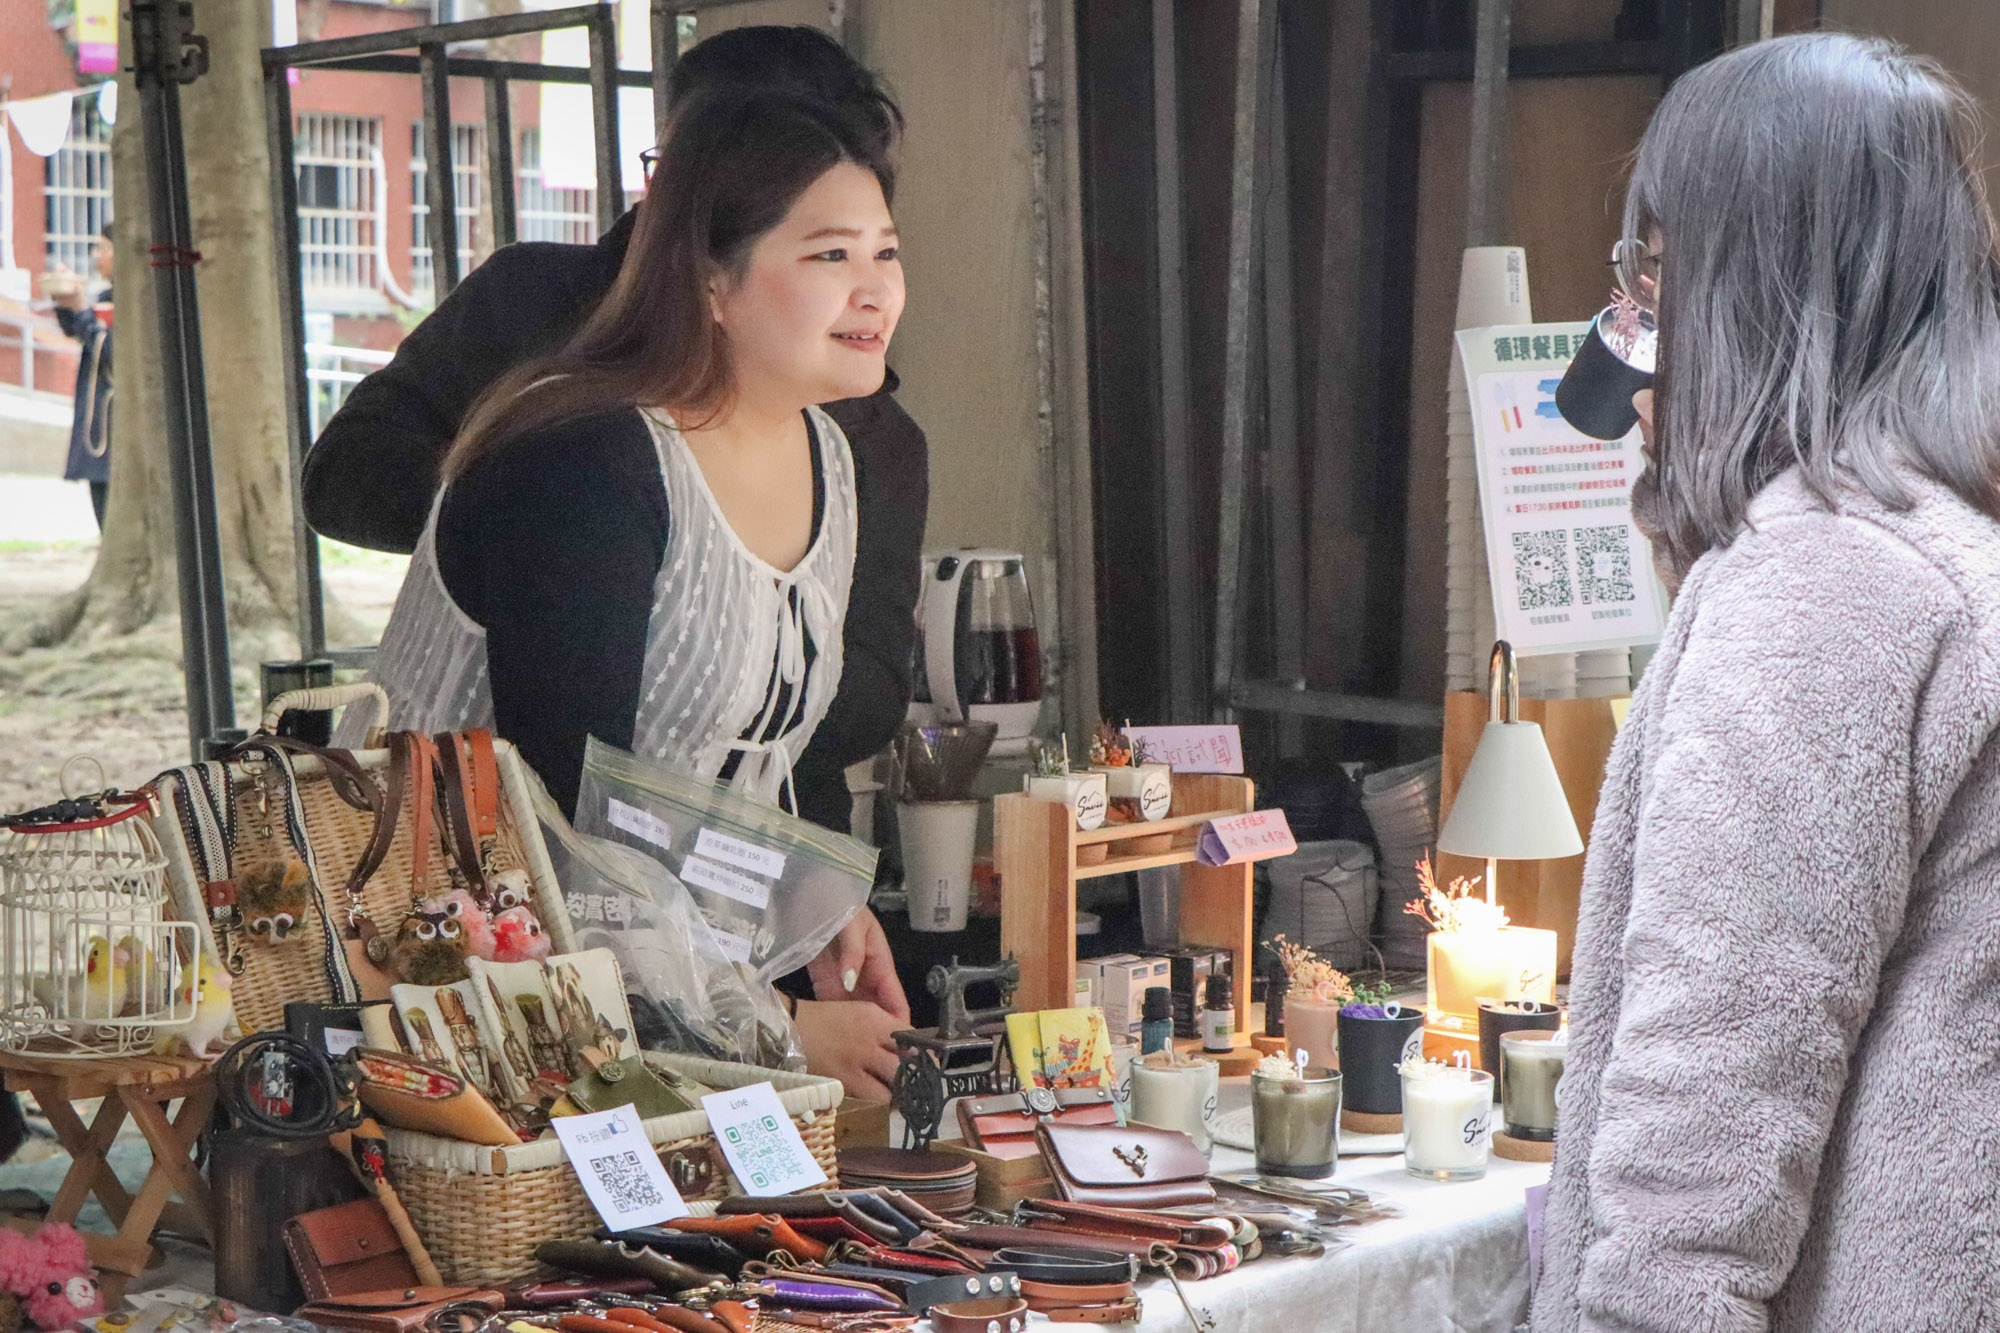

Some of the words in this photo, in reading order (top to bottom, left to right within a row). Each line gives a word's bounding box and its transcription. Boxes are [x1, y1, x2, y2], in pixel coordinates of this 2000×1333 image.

[748, 851, 761, 861] 150
[740, 883, 755, 894] 250
[729, 1098, 749, 1110] Line
